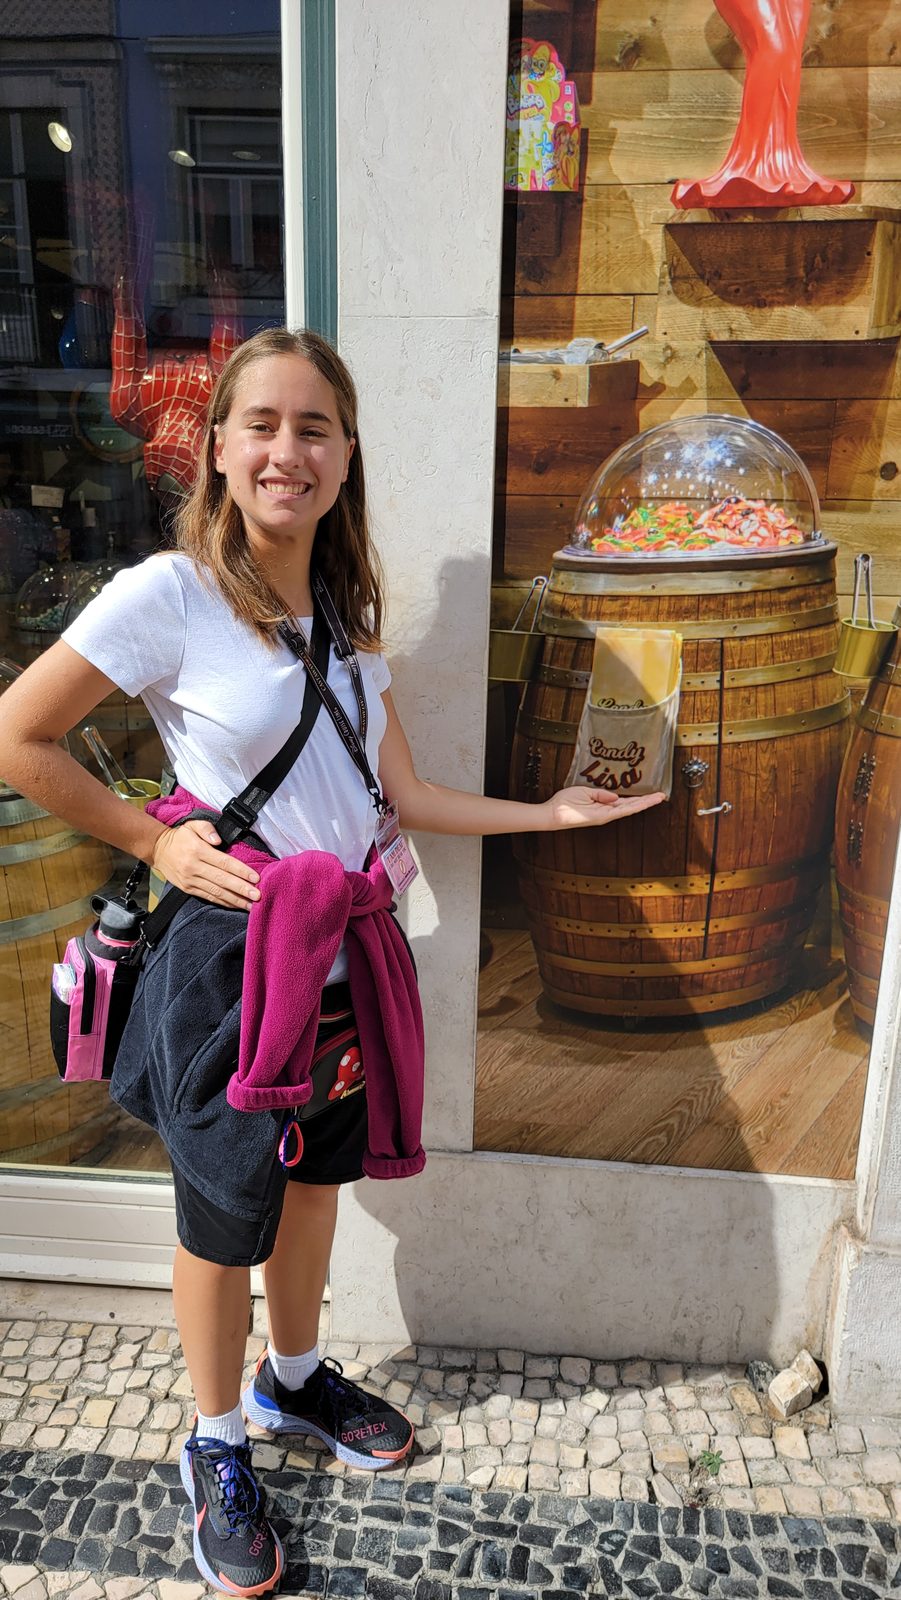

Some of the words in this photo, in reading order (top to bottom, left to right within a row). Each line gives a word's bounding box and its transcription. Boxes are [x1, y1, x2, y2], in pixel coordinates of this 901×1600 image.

[589, 738, 645, 767] Candy
[580, 760, 642, 790] Lisa
[341, 1422, 388, 1443] GORE-TEX
